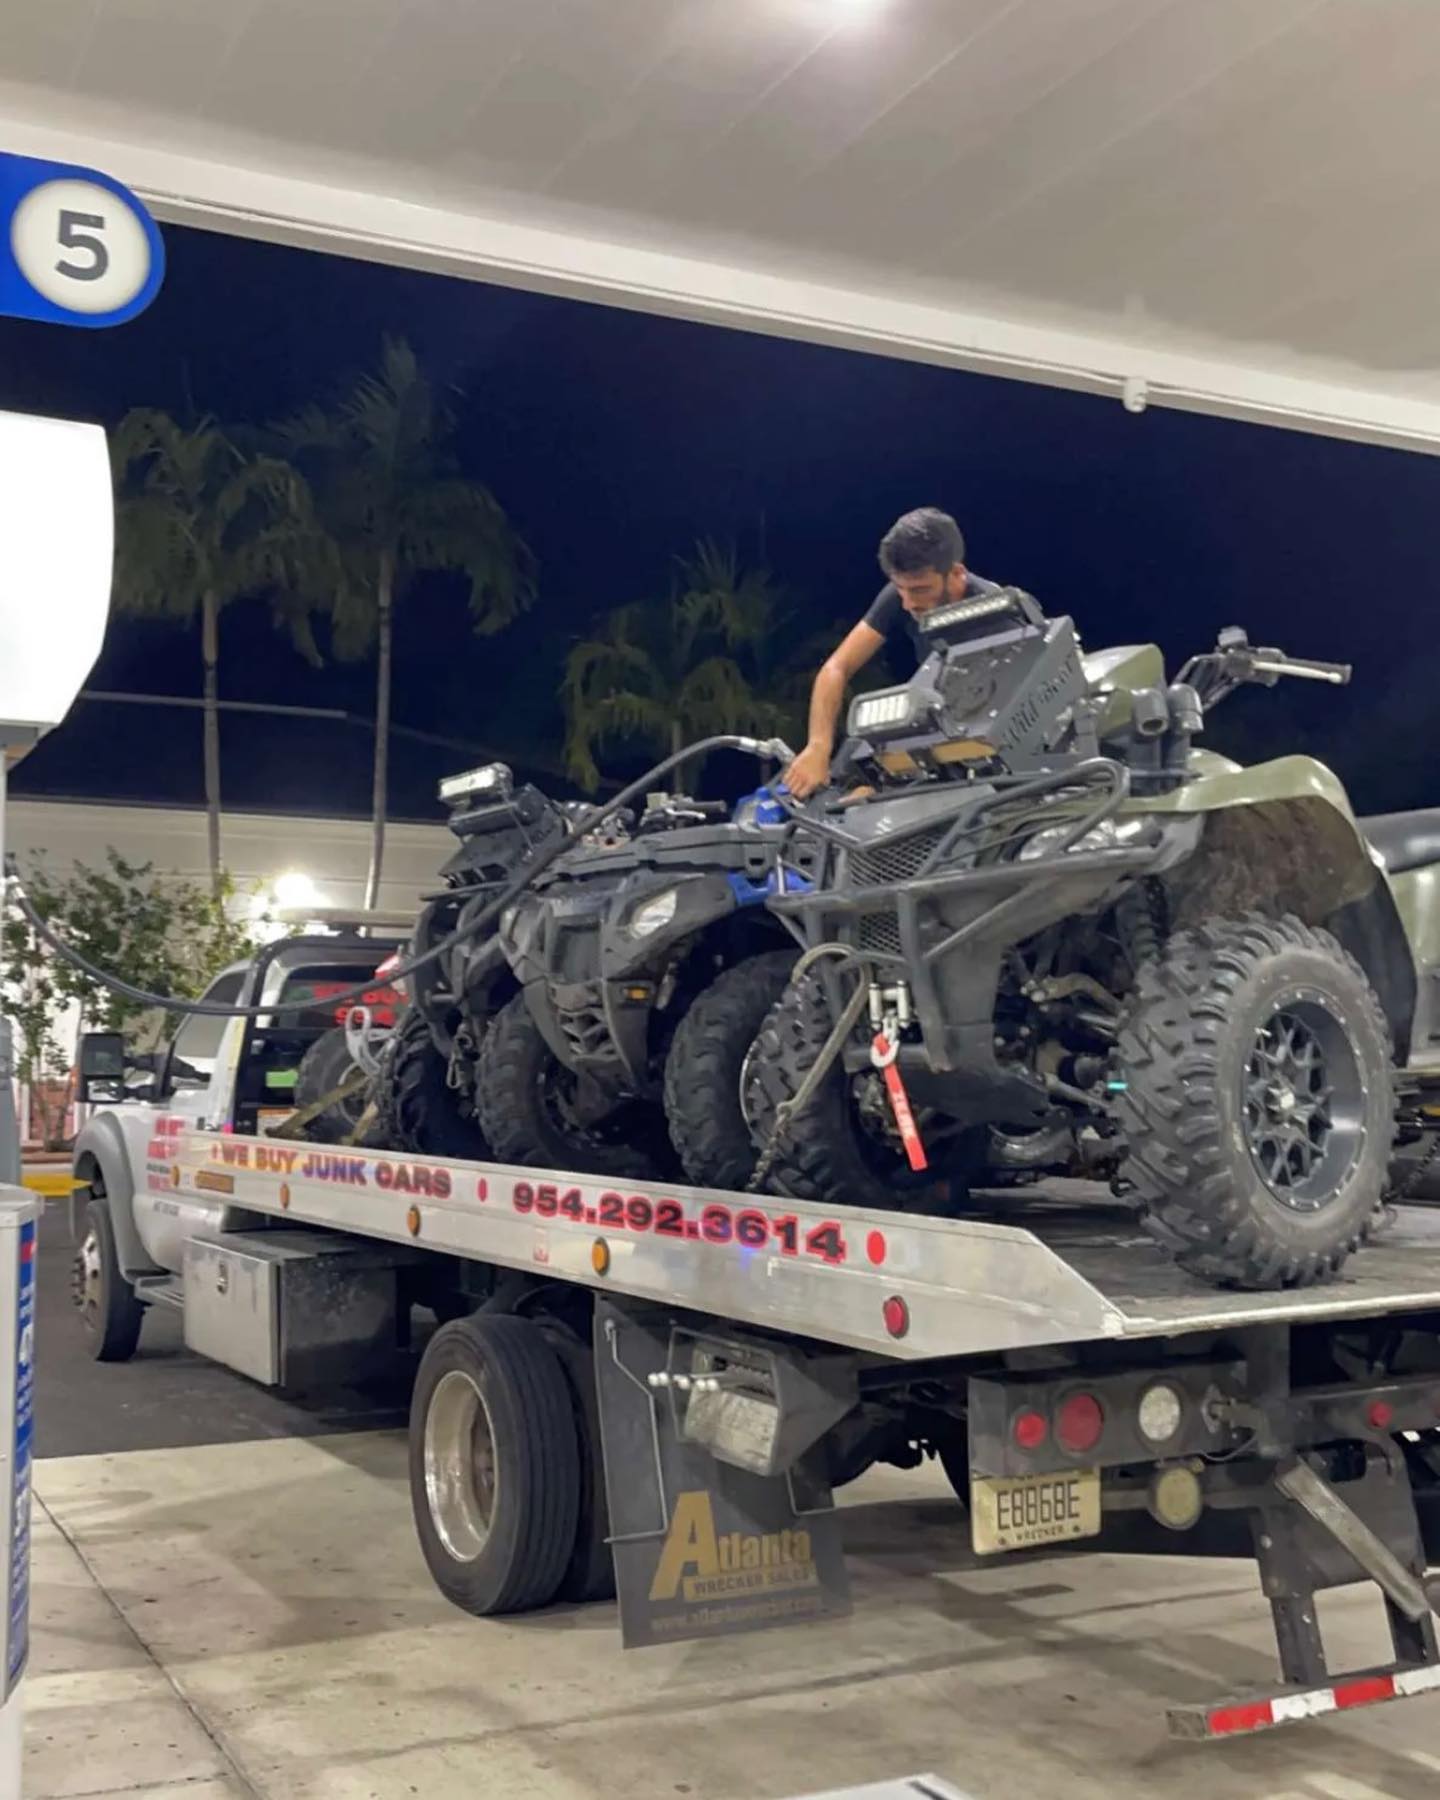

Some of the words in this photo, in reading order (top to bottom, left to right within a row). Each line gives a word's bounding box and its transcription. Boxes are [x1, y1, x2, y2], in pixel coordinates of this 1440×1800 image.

[54, 208, 110, 282] 5
[221, 1142, 249, 1166] WE
[256, 1146, 298, 1175] BUY
[301, 1153, 368, 1187] JUNK
[374, 1159, 452, 1199] CARS
[512, 1180, 848, 1266] 954.292.3614
[648, 1489, 812, 1601] Atlanta
[693, 1573, 764, 1595] WRECKER
